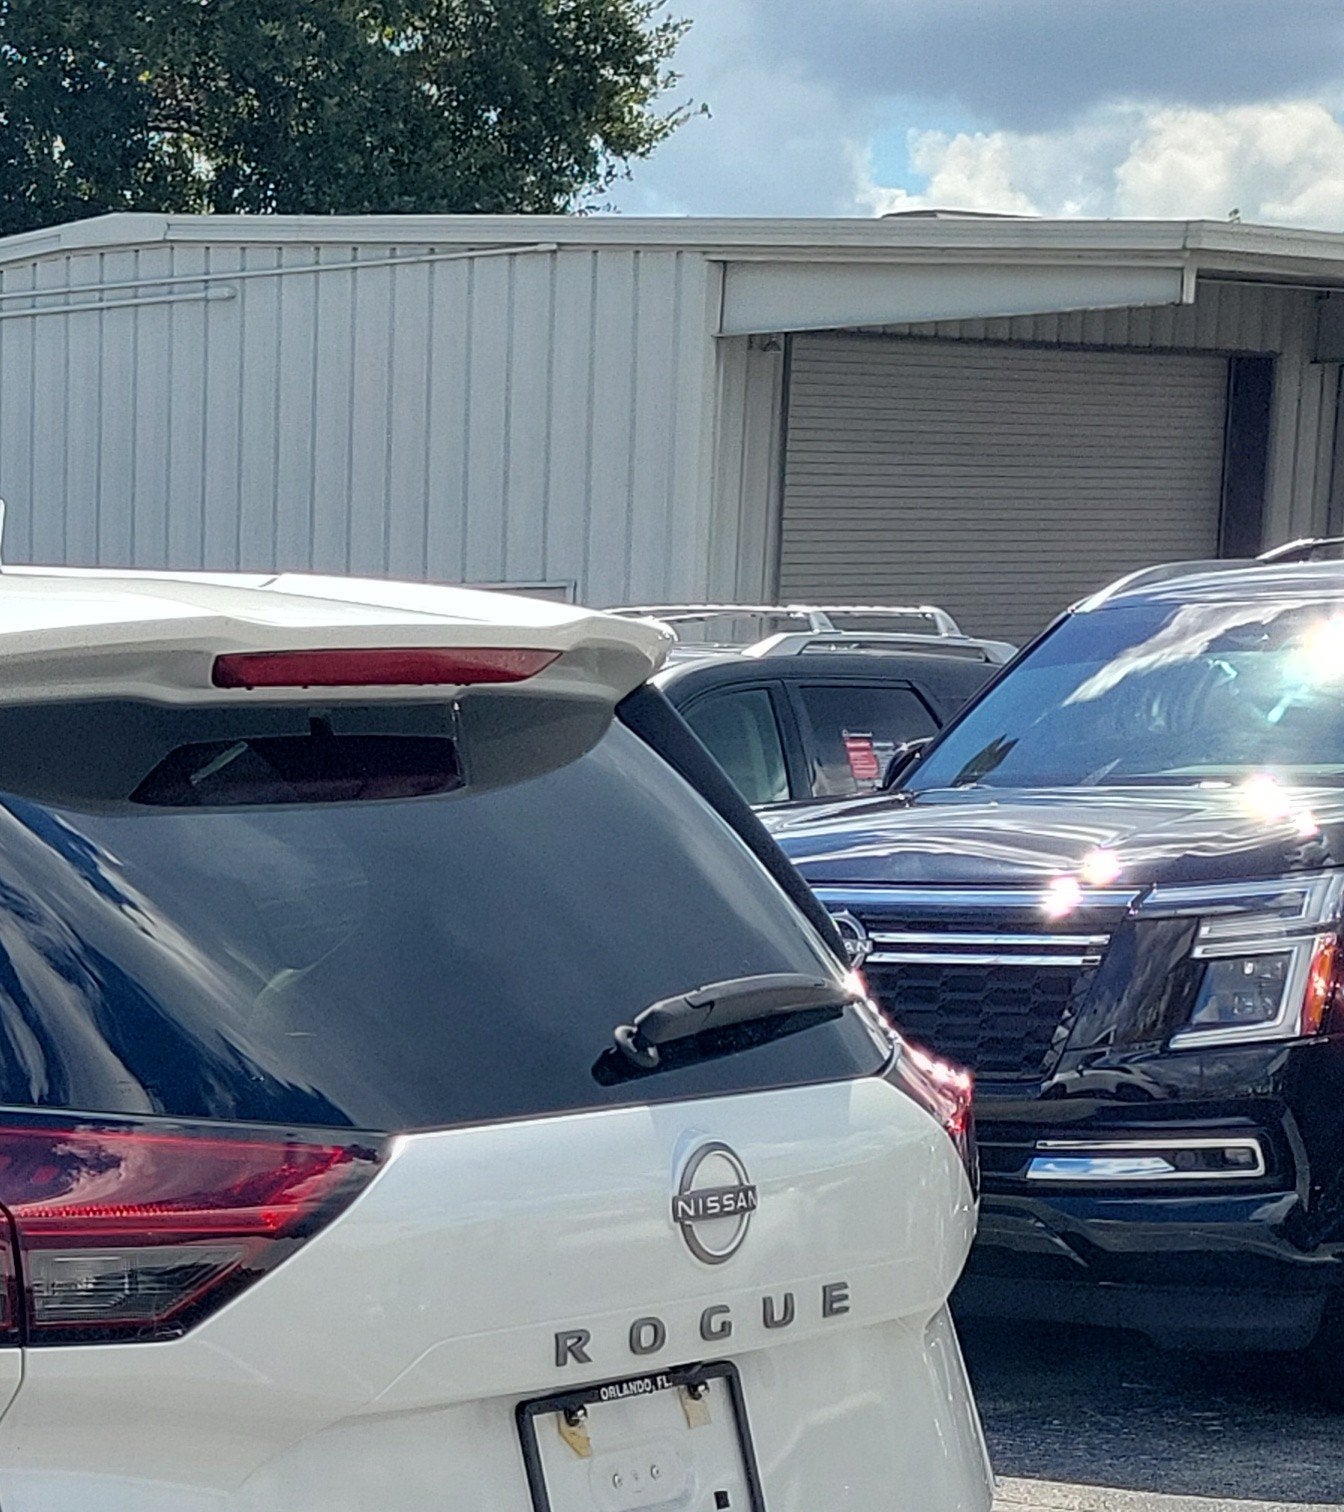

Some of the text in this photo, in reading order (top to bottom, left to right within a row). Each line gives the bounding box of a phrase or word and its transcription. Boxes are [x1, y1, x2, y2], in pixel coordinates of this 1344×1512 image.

[677, 1184, 758, 1219] NISSAN
[554, 1281, 851, 1368] ROGUE
[600, 1377, 653, 1400] ORLANDO,
